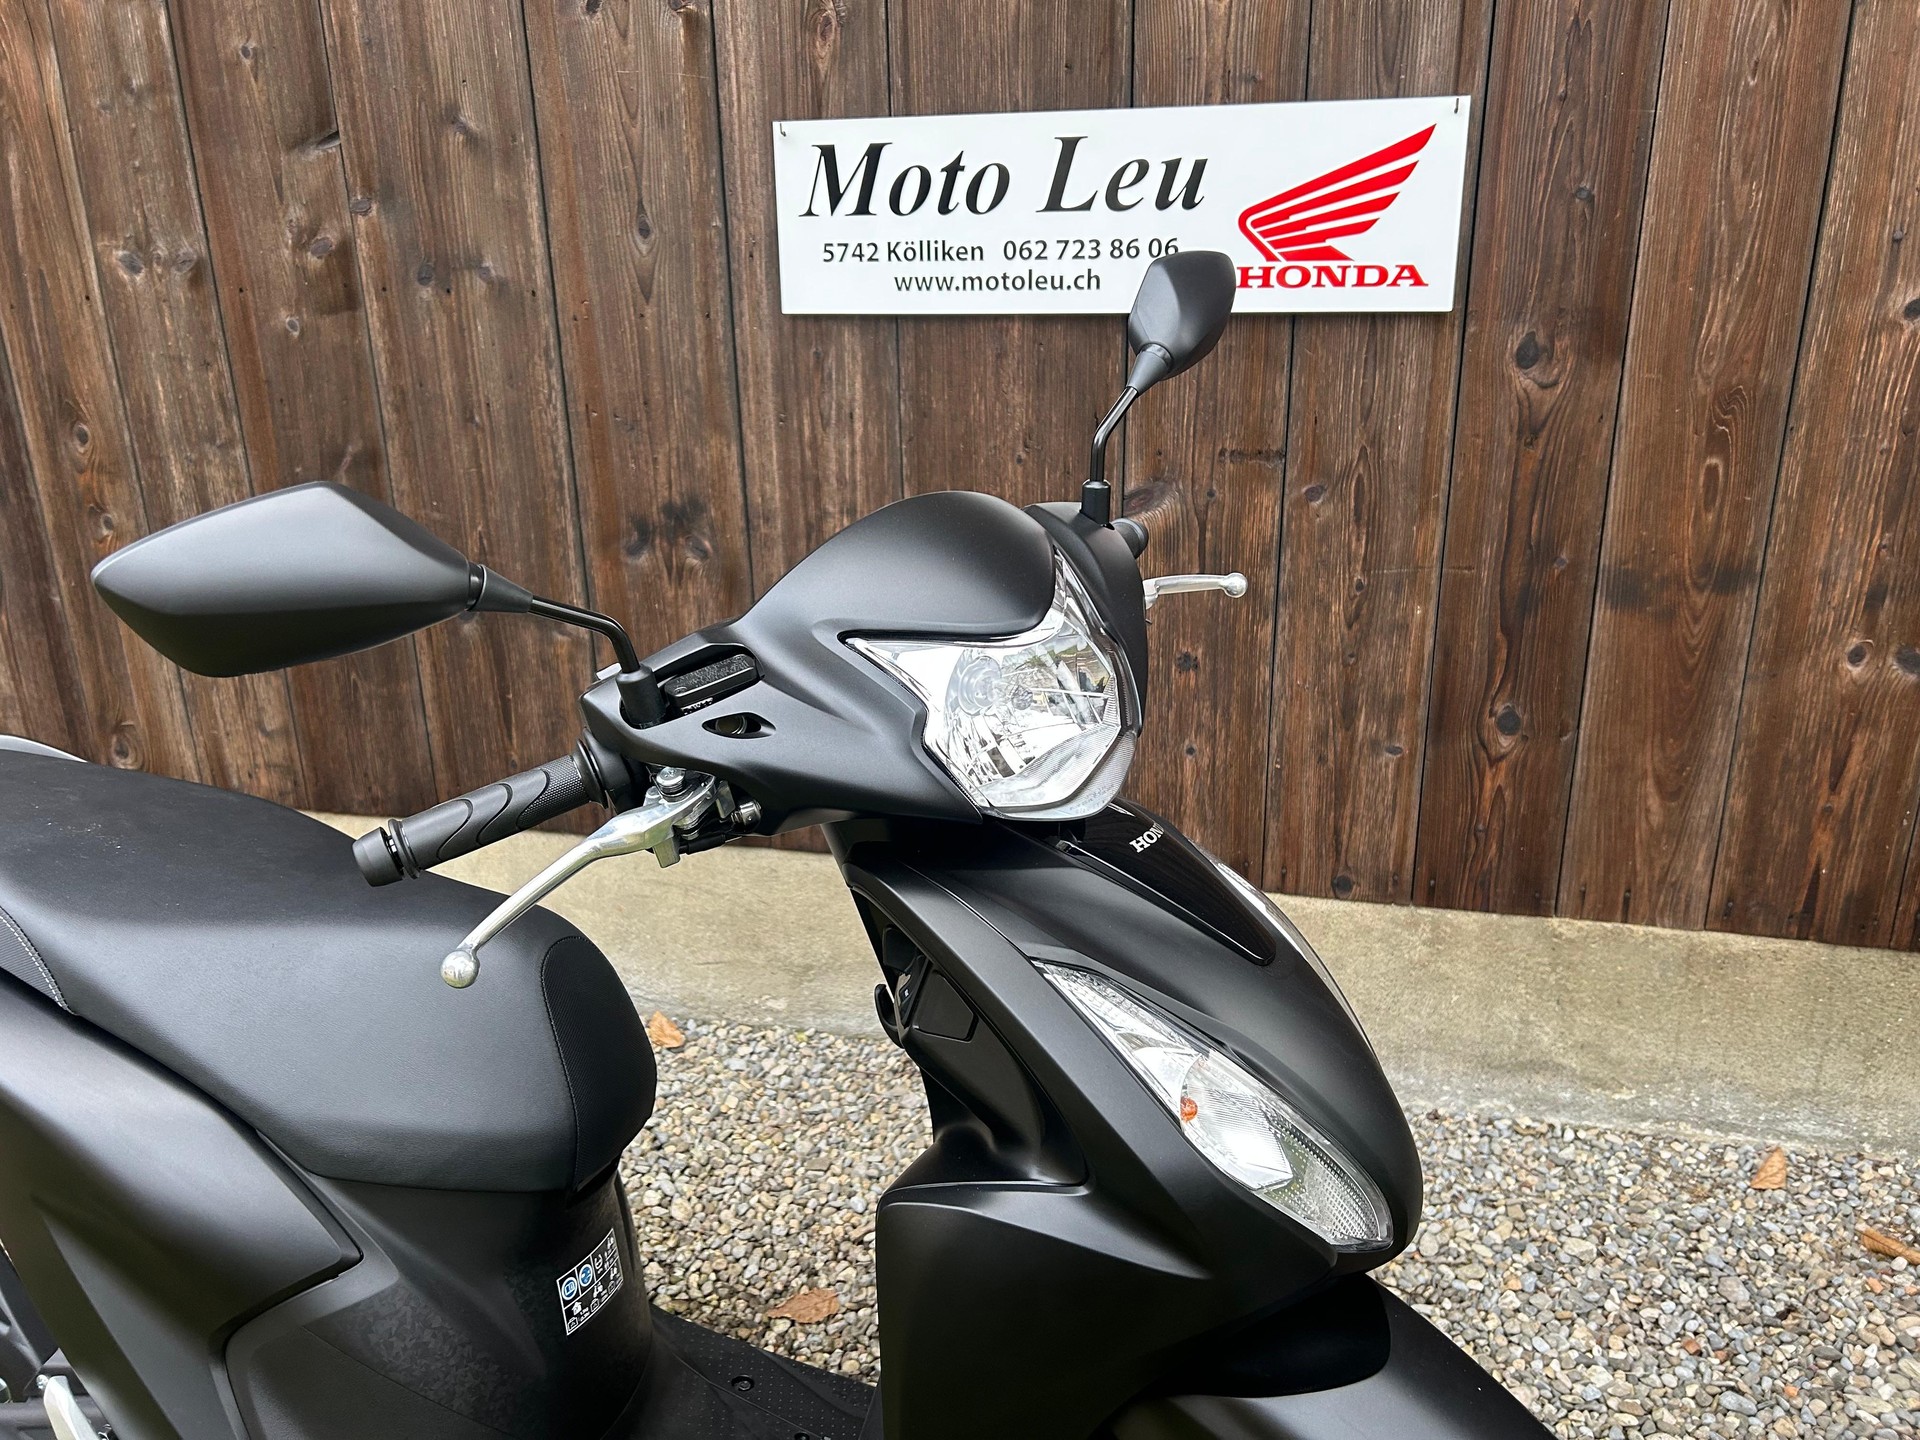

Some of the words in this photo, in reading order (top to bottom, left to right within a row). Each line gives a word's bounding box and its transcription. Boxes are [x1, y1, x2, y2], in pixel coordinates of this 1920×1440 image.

[798, 141, 1010, 217] Moto
[1036, 135, 1209, 213] Leu
[822, 242, 879, 263] 5742
[887, 239, 984, 262] Kölliken
[1003, 239, 1048, 261] 062
[1056, 239, 1101, 260] 723
[1110, 238, 1140, 259] 86
[1148, 237, 1179, 258] 06
[894, 268, 1101, 292] www.motoleu.ch
[1236, 264, 1428, 290] HONDA
[1128, 822, 1165, 853] HON
